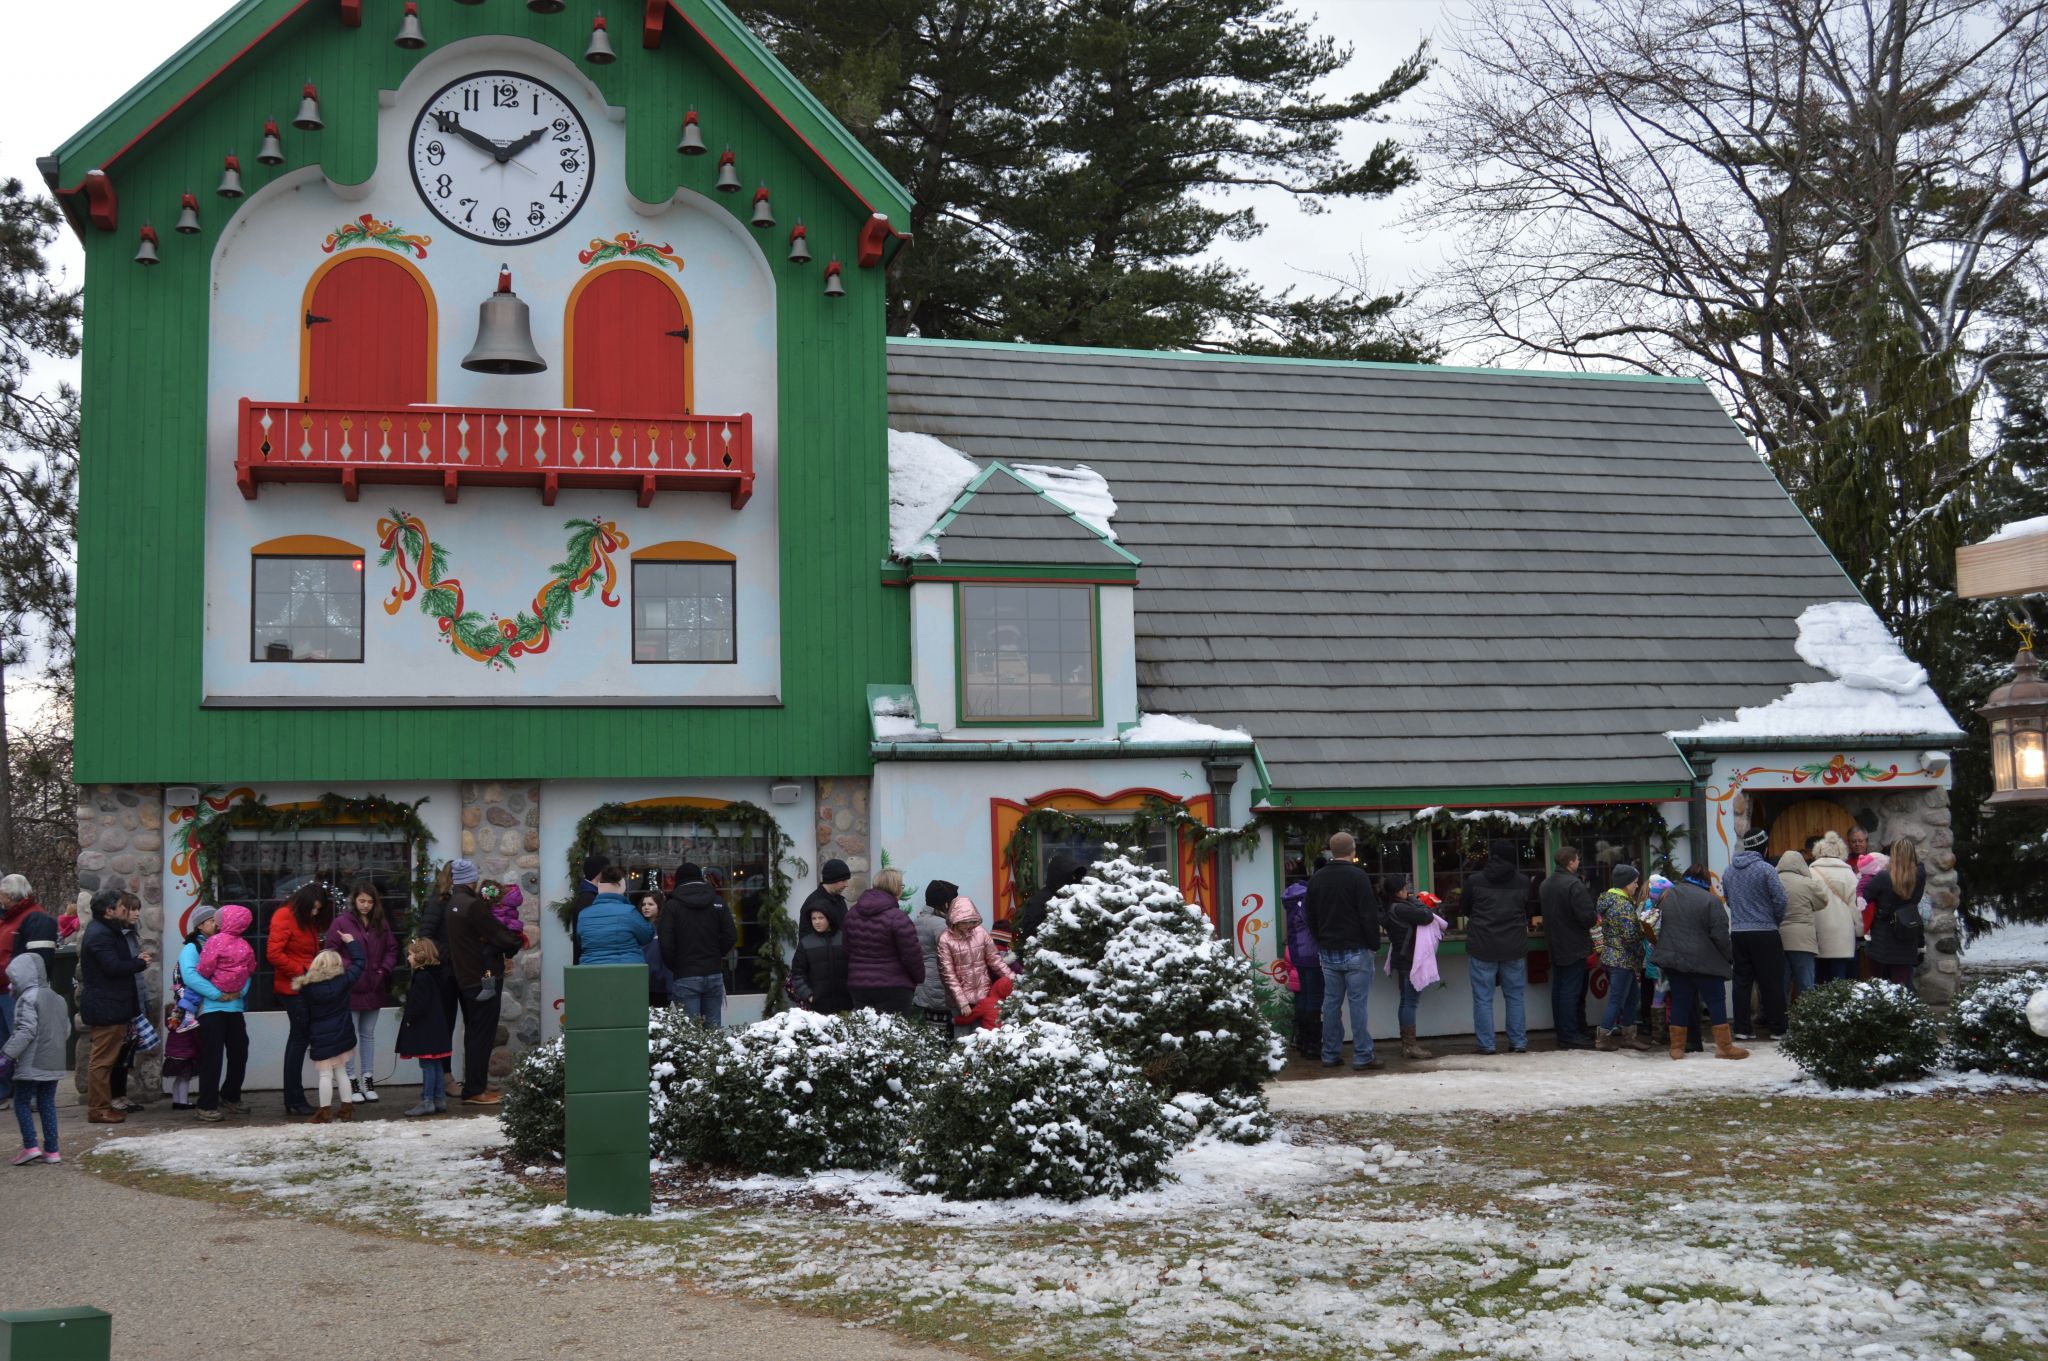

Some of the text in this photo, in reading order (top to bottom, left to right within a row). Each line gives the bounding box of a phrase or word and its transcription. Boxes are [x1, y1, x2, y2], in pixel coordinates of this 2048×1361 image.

[463, 88, 480, 112] 11
[492, 84, 519, 108] 12
[532, 93, 540, 116] 1
[552, 118, 571, 142] 2
[426, 140, 446, 166] 9
[559, 147, 580, 173] 3
[435, 173, 453, 198] 8
[549, 180, 568, 204] 4
[459, 198, 479, 223] 7
[491, 207, 512, 233] 6
[526, 201, 546, 226] 5
